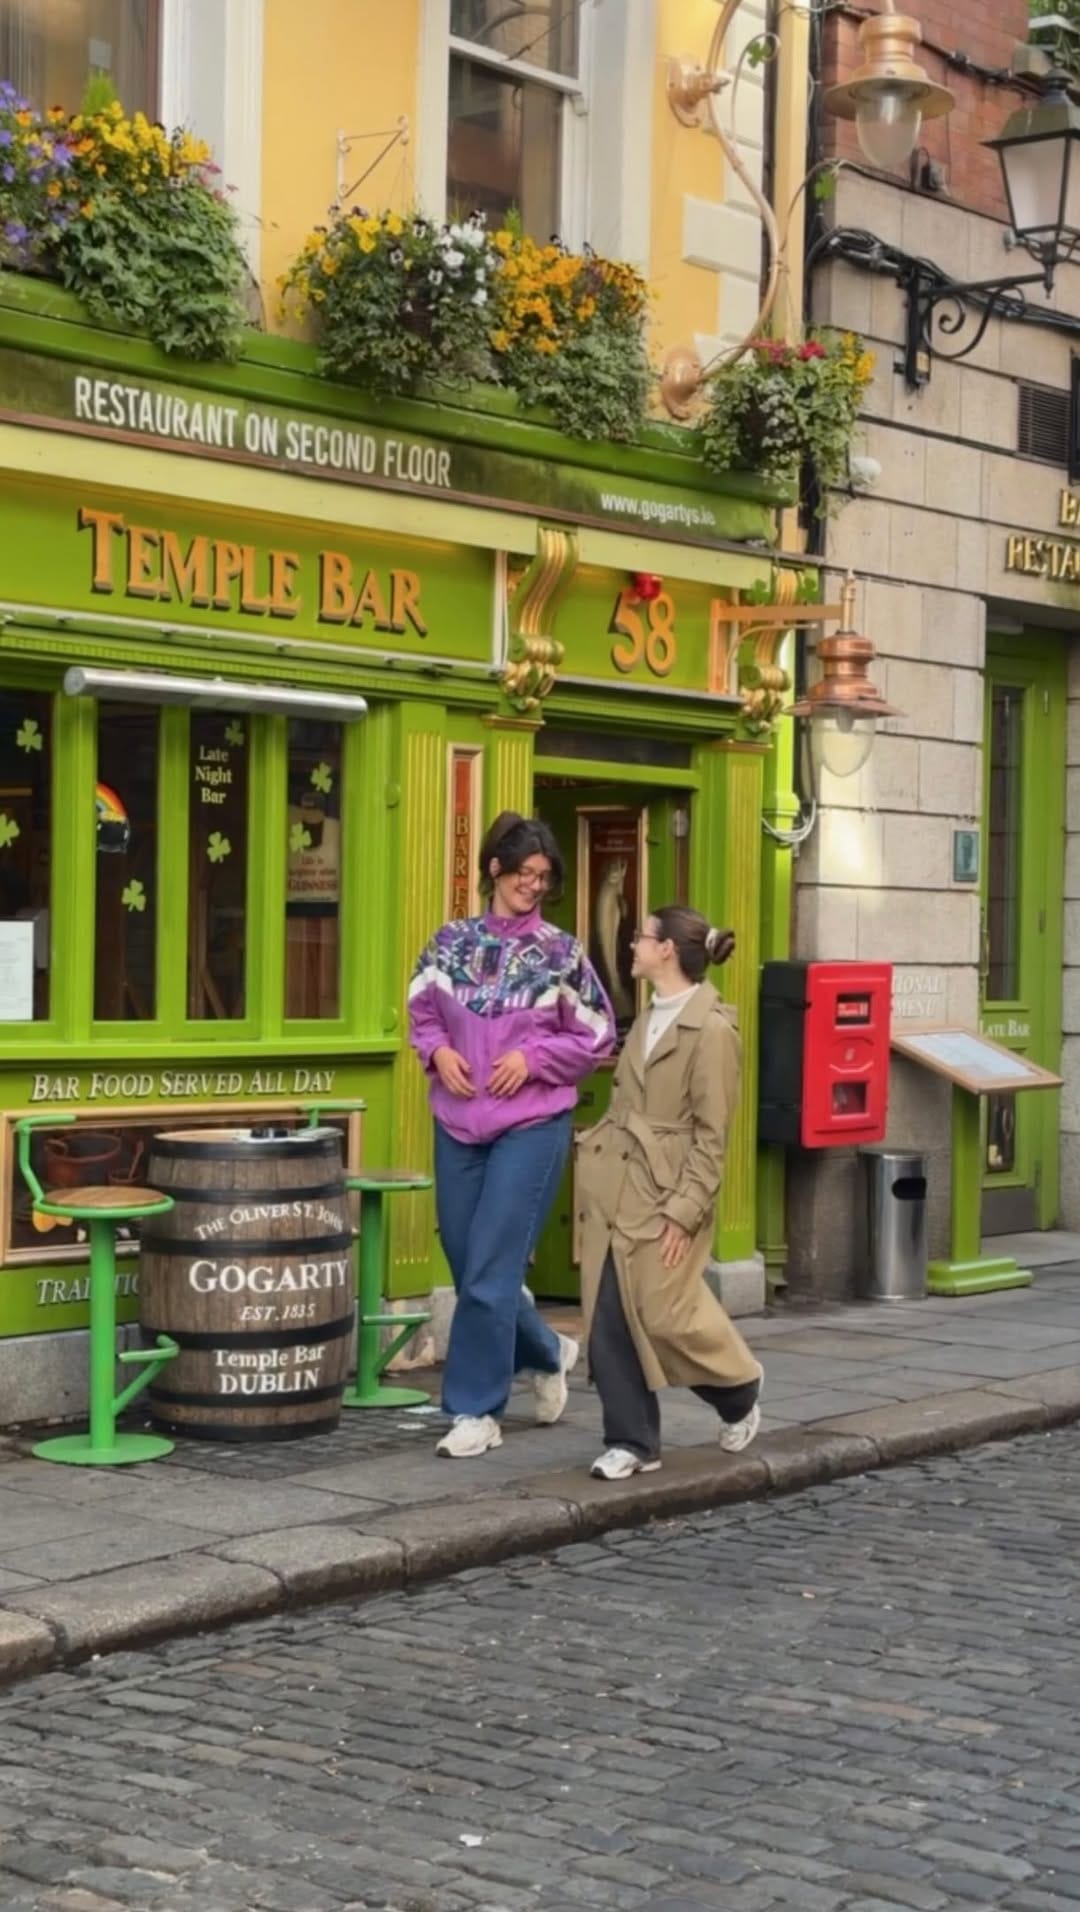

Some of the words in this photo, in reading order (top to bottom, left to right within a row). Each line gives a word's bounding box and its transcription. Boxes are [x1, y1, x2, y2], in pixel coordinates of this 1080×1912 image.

[75, 377, 238, 449] RESTAURANT
[244, 413, 279, 456] ON
[285, 421, 376, 474] SECOND
[383, 439, 452, 487] FLOOR
[601, 493, 716, 527] www.gogartys.ie
[78, 507, 301, 619] TEMPLE
[318, 550, 428, 637] BAR
[608, 587, 676, 676] 58
[200, 745, 229, 762] Late
[195, 766, 232, 786] Night
[201, 787, 227, 804] Bar
[32, 1074, 80, 1101] BAR
[88, 1073, 154, 1099] FOOD
[160, 1070, 243, 1096] SERVED
[247, 1070, 287, 1094] ALL
[293, 1069, 336, 1093] DAY
[194, 1217, 226, 1240] THE
[229, 1204, 289, 1225] OLIVER
[189, 1260, 348, 1293] GOGARTY
[213, 1349, 289, 1371] Temple
[294, 1345, 326, 1364] Bar
[219, 1368, 320, 1394] DUBLIN
